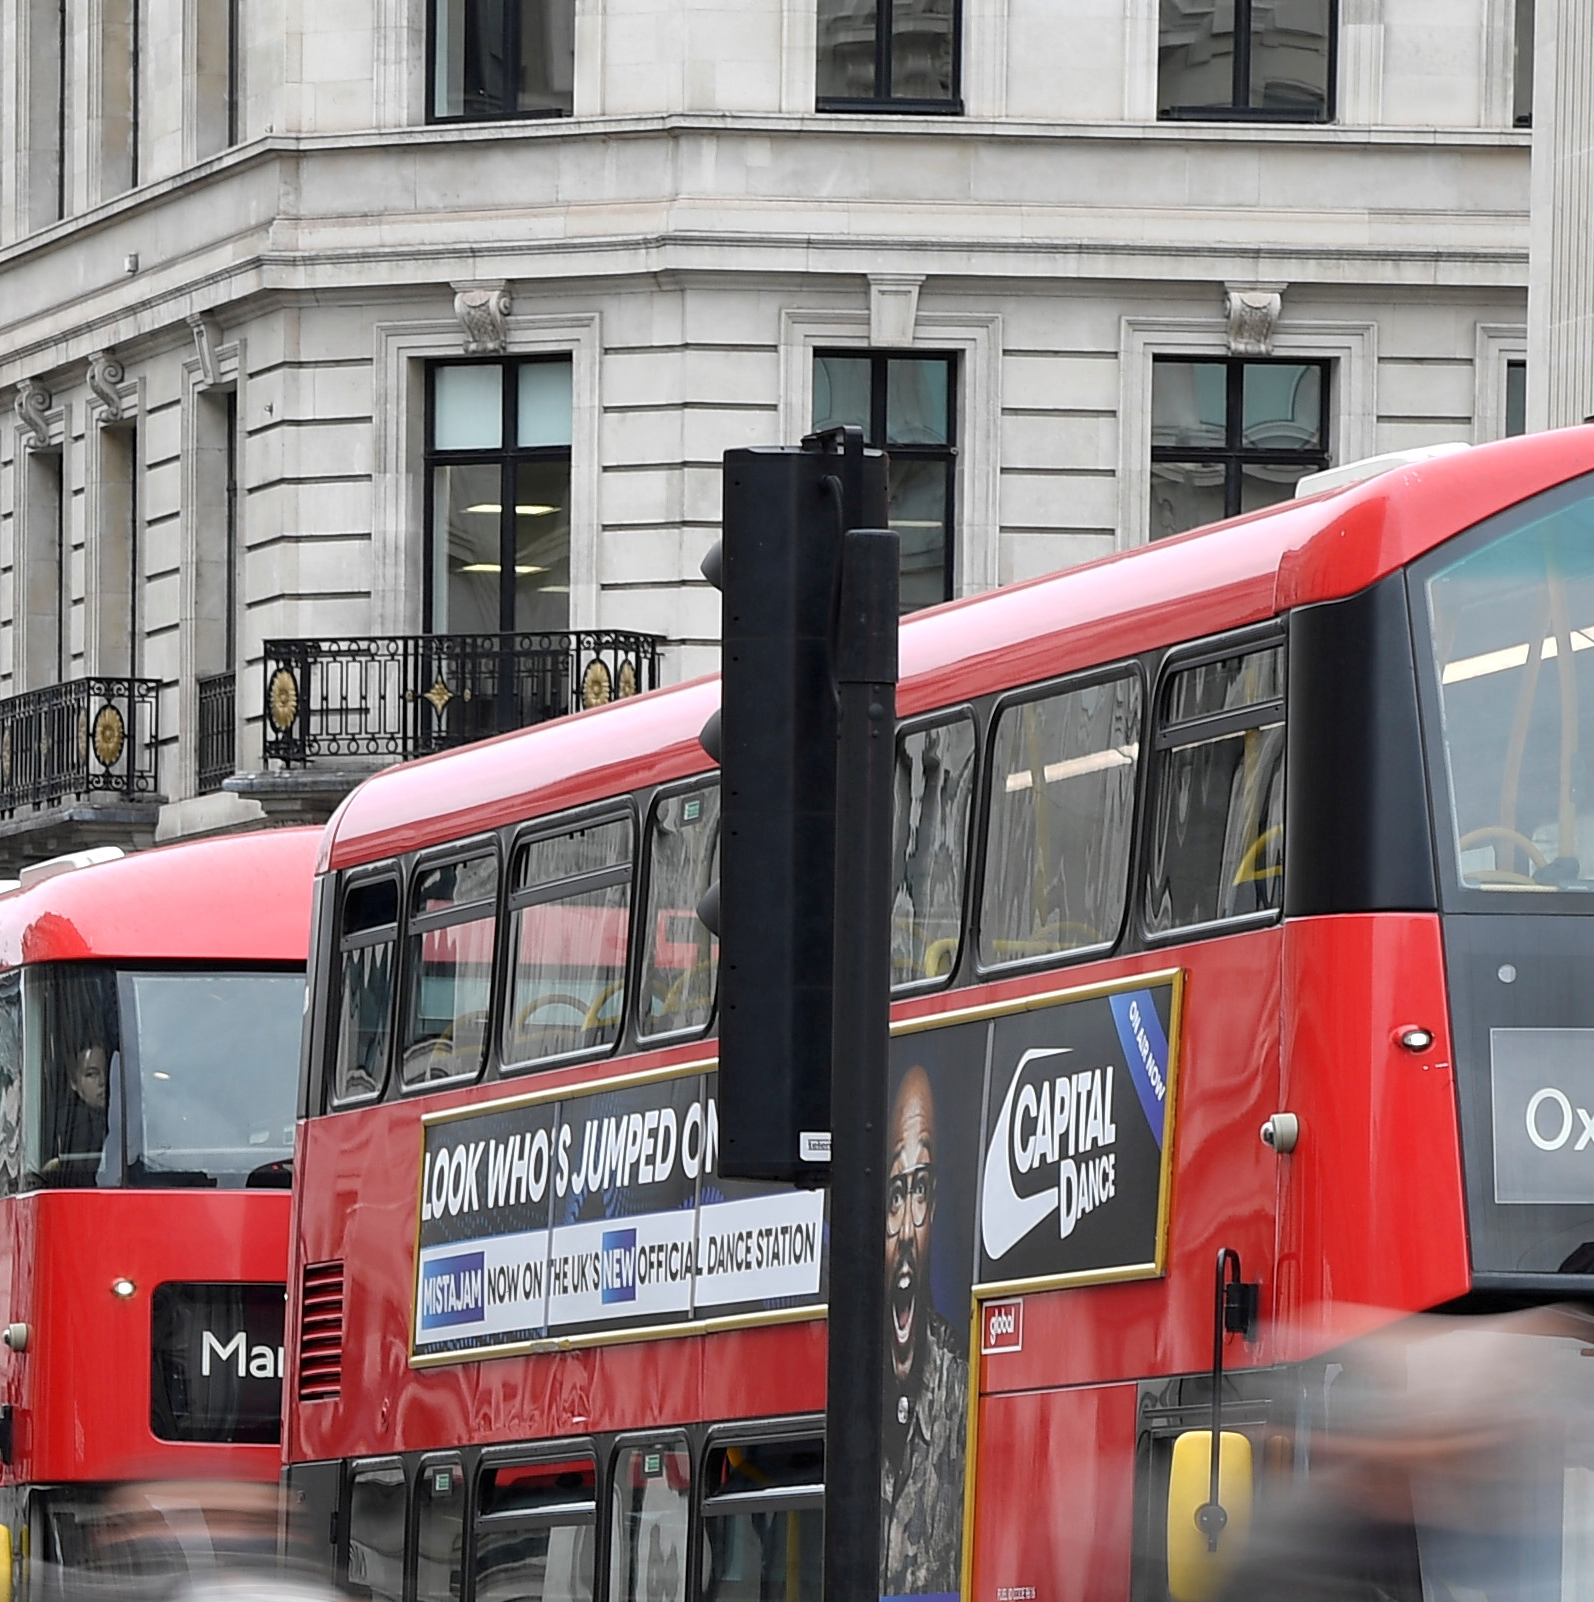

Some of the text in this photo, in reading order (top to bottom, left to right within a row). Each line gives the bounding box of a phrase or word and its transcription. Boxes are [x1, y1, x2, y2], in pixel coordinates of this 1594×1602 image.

[1129, 1000, 1166, 1101] ON AIR NOW
[421, 1098, 720, 1221] LOOK WHO'S JUMPED ON
[1014, 1066, 1116, 1174] CAPITAL
[1060, 1153, 1115, 1239] DANCE
[423, 1222, 816, 1317] MISTAJAM NOW ON THE UK'S NEW OFFICIAL DANCE STATION
[989, 1309, 1015, 1346] global
